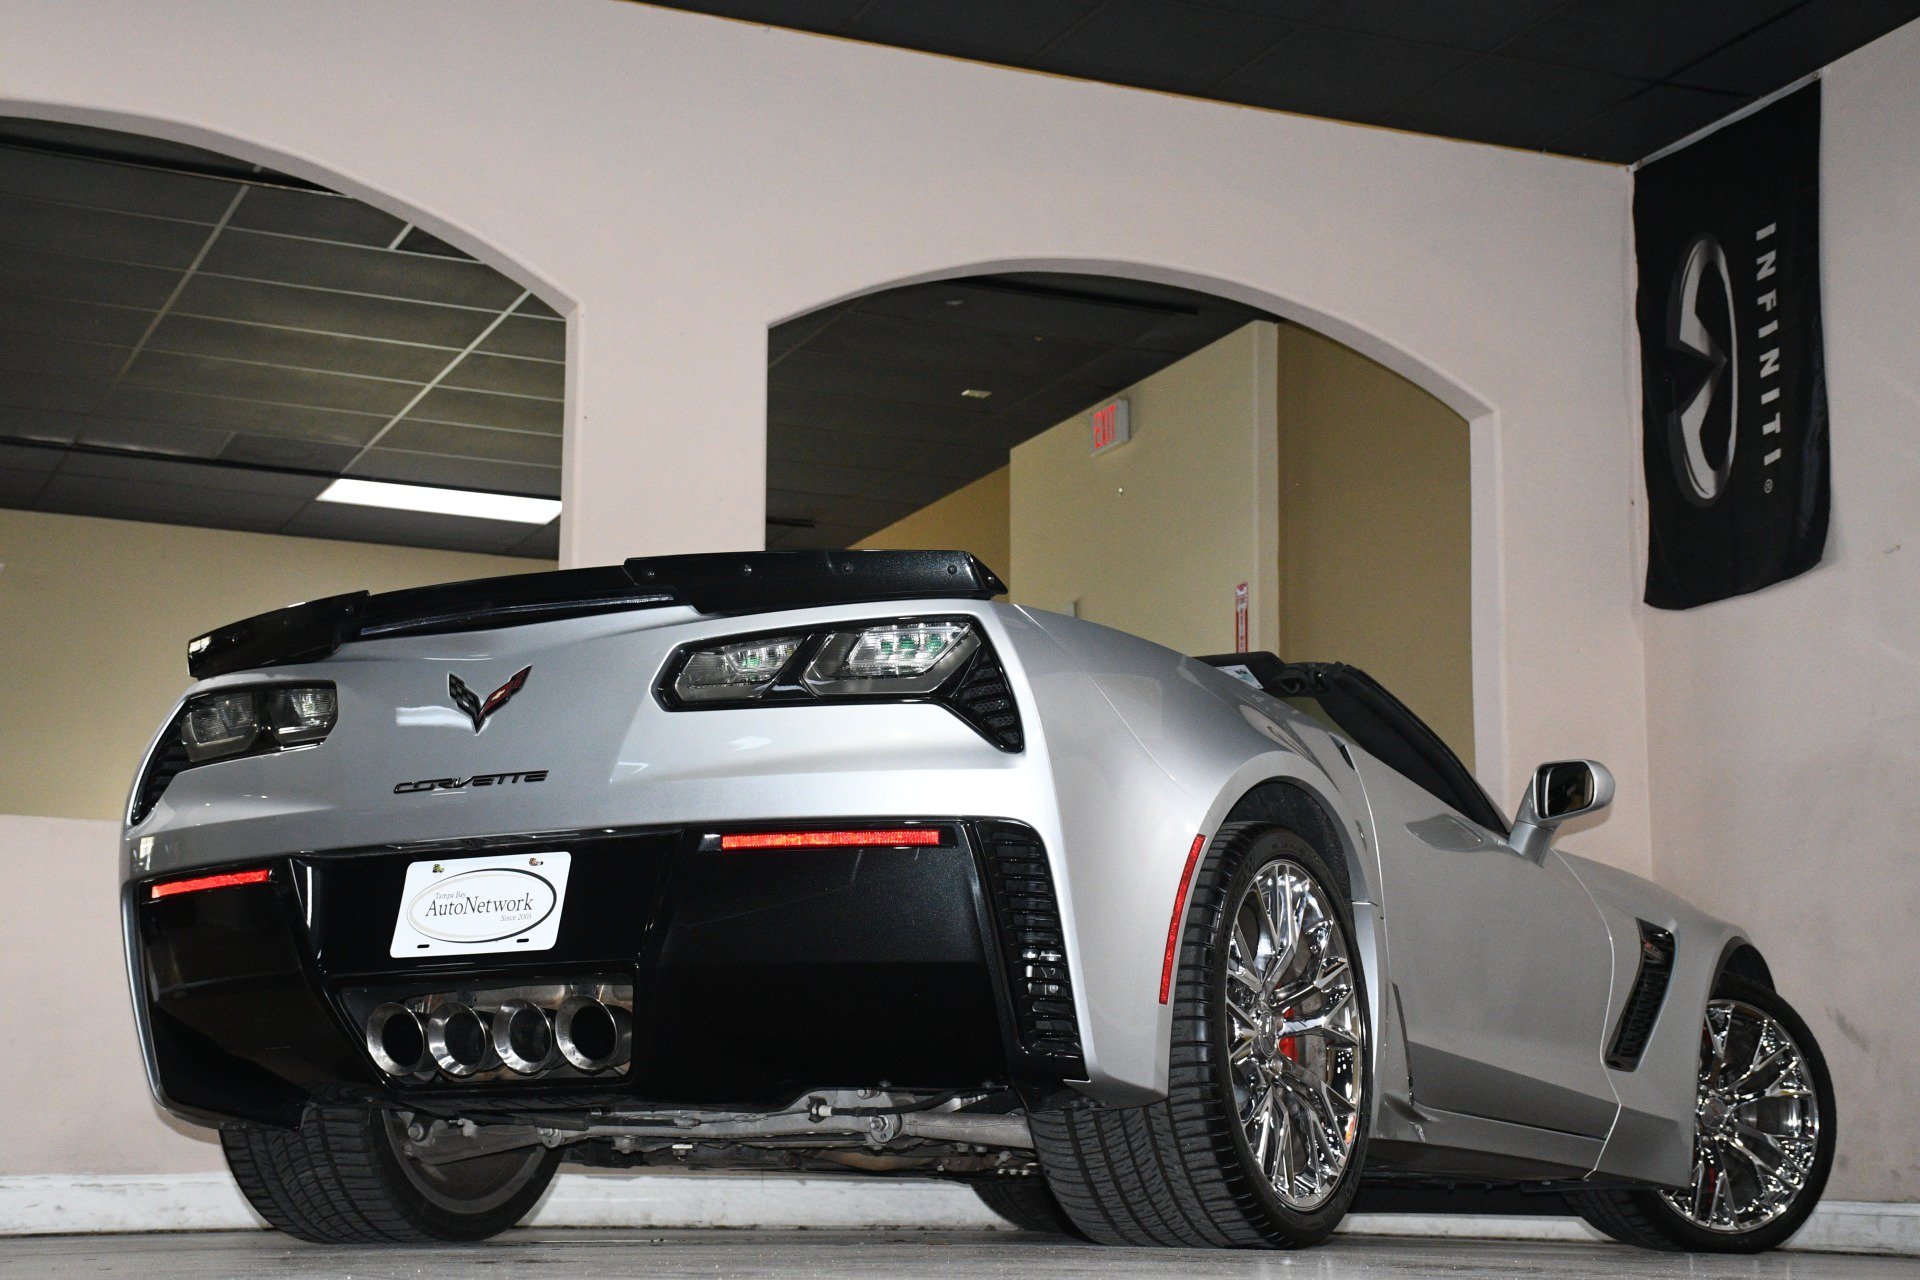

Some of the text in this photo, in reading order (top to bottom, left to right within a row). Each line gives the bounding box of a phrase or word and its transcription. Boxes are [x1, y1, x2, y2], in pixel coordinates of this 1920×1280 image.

[1756, 222, 1781, 466] INFINITI
[1094, 404, 1116, 448] EXIT
[393, 770, 549, 794] CORVETTE
[425, 892, 534, 917] AutoNetwork
[500, 914, 516, 922] Since
